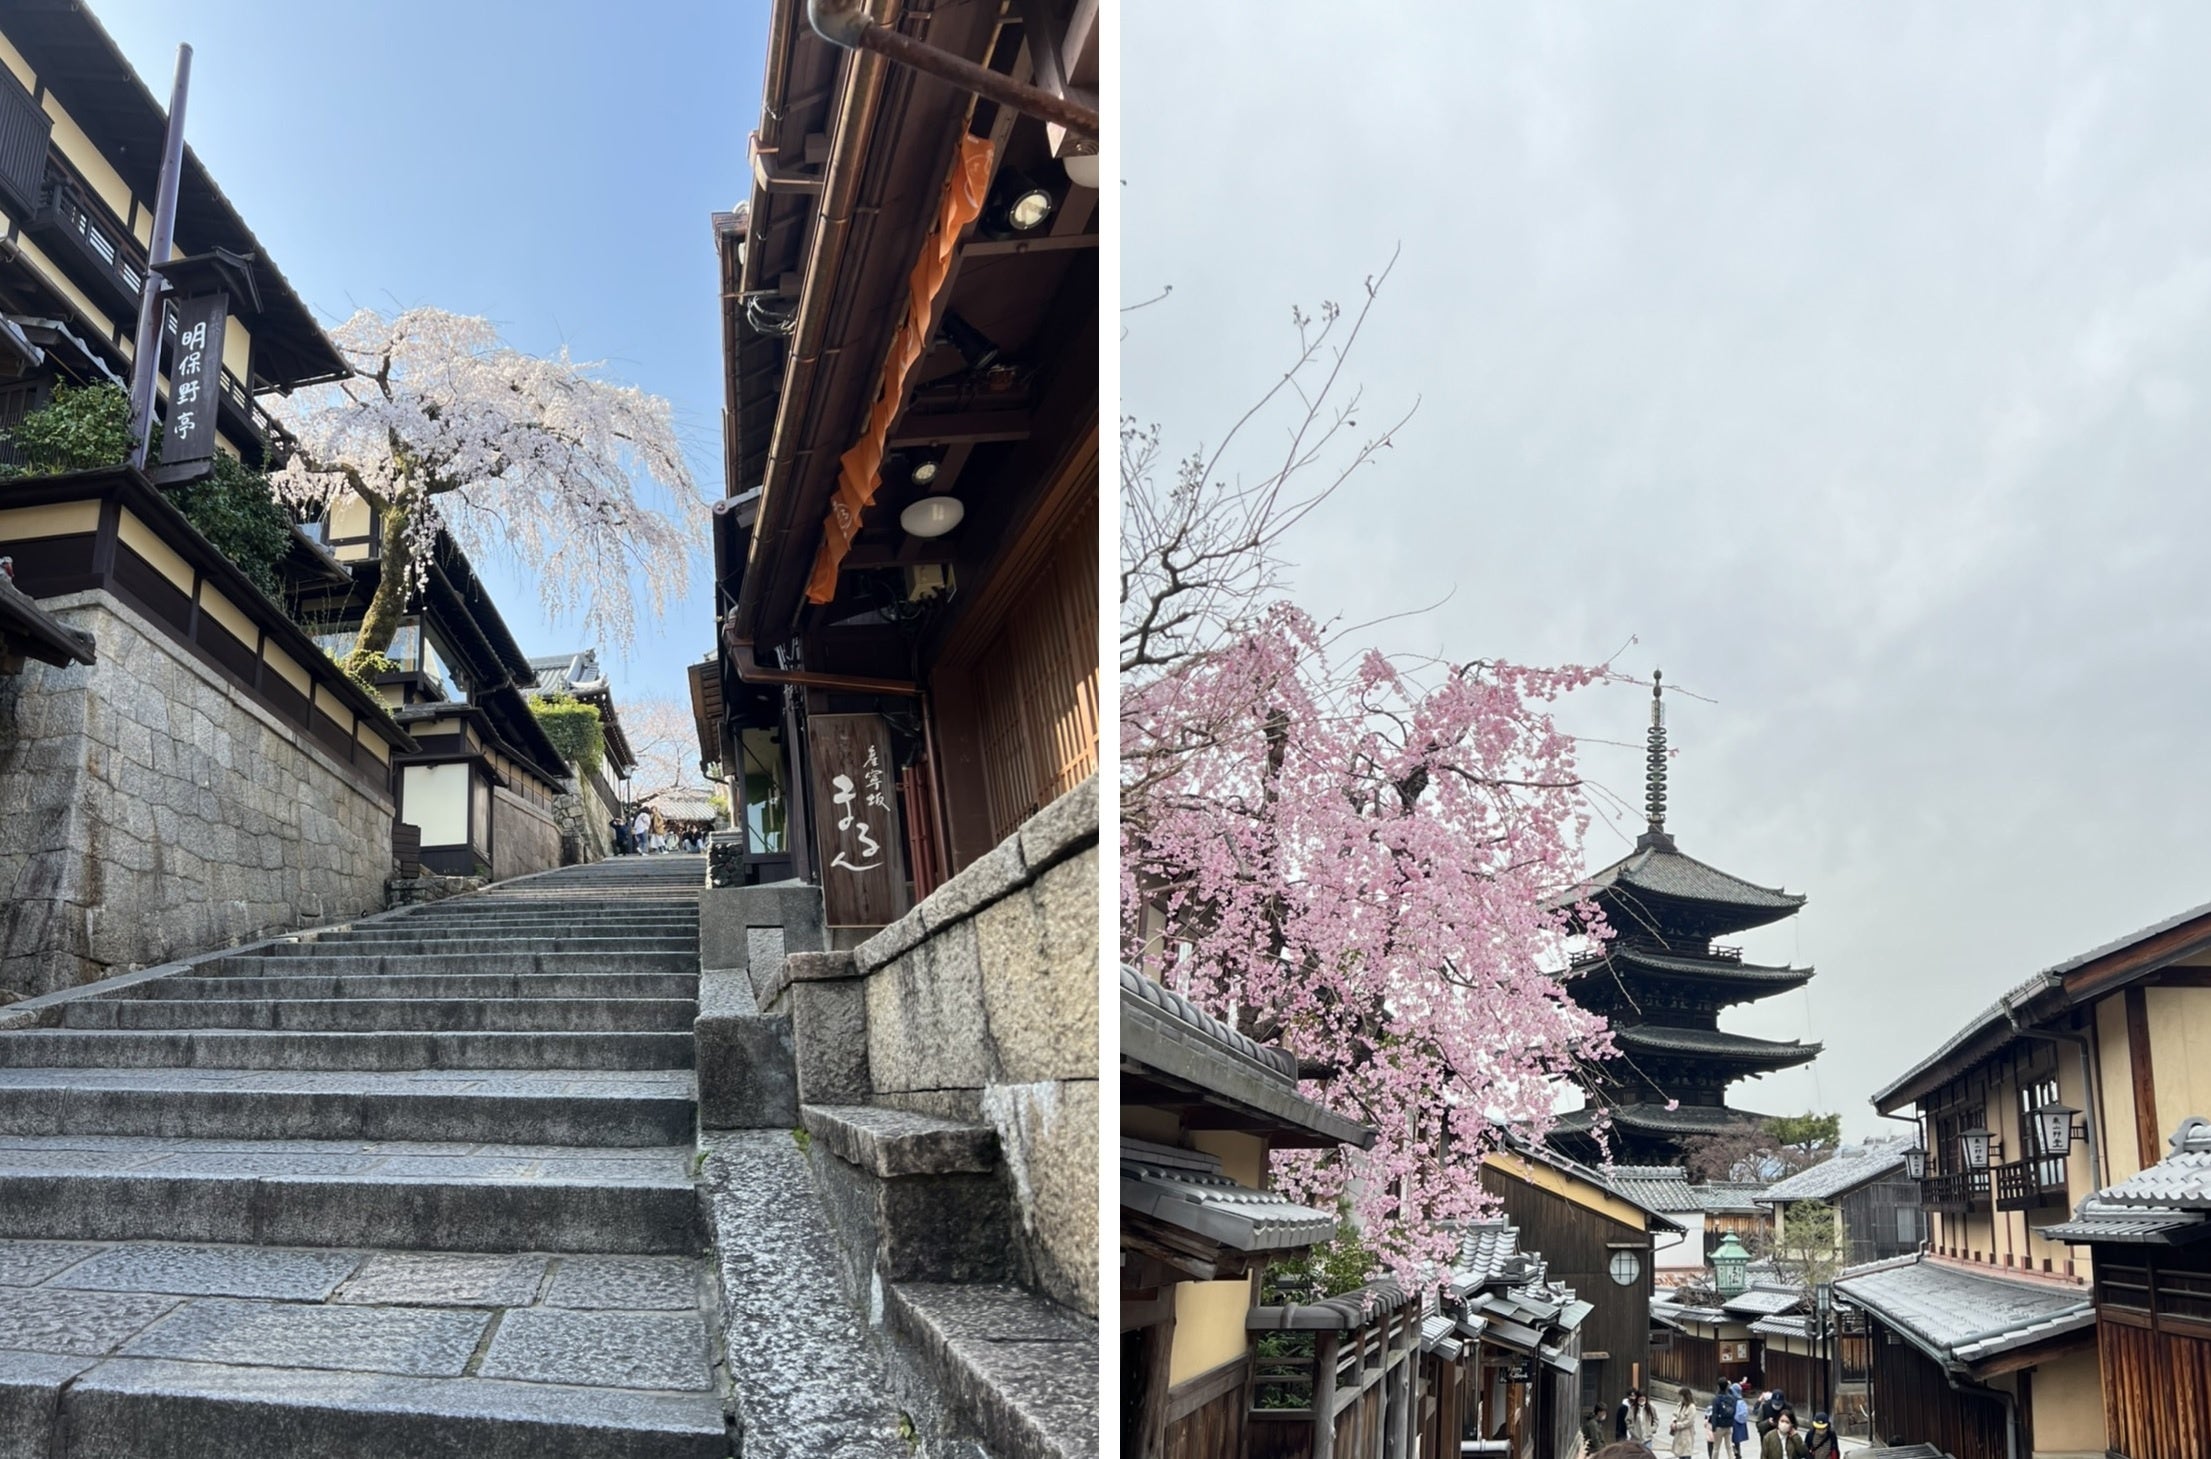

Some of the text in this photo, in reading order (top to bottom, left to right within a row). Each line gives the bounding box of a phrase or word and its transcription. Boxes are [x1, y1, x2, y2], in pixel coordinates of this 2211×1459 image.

[174, 321, 207, 440] 明保野亭
[863, 744, 891, 812] 産寧坂
